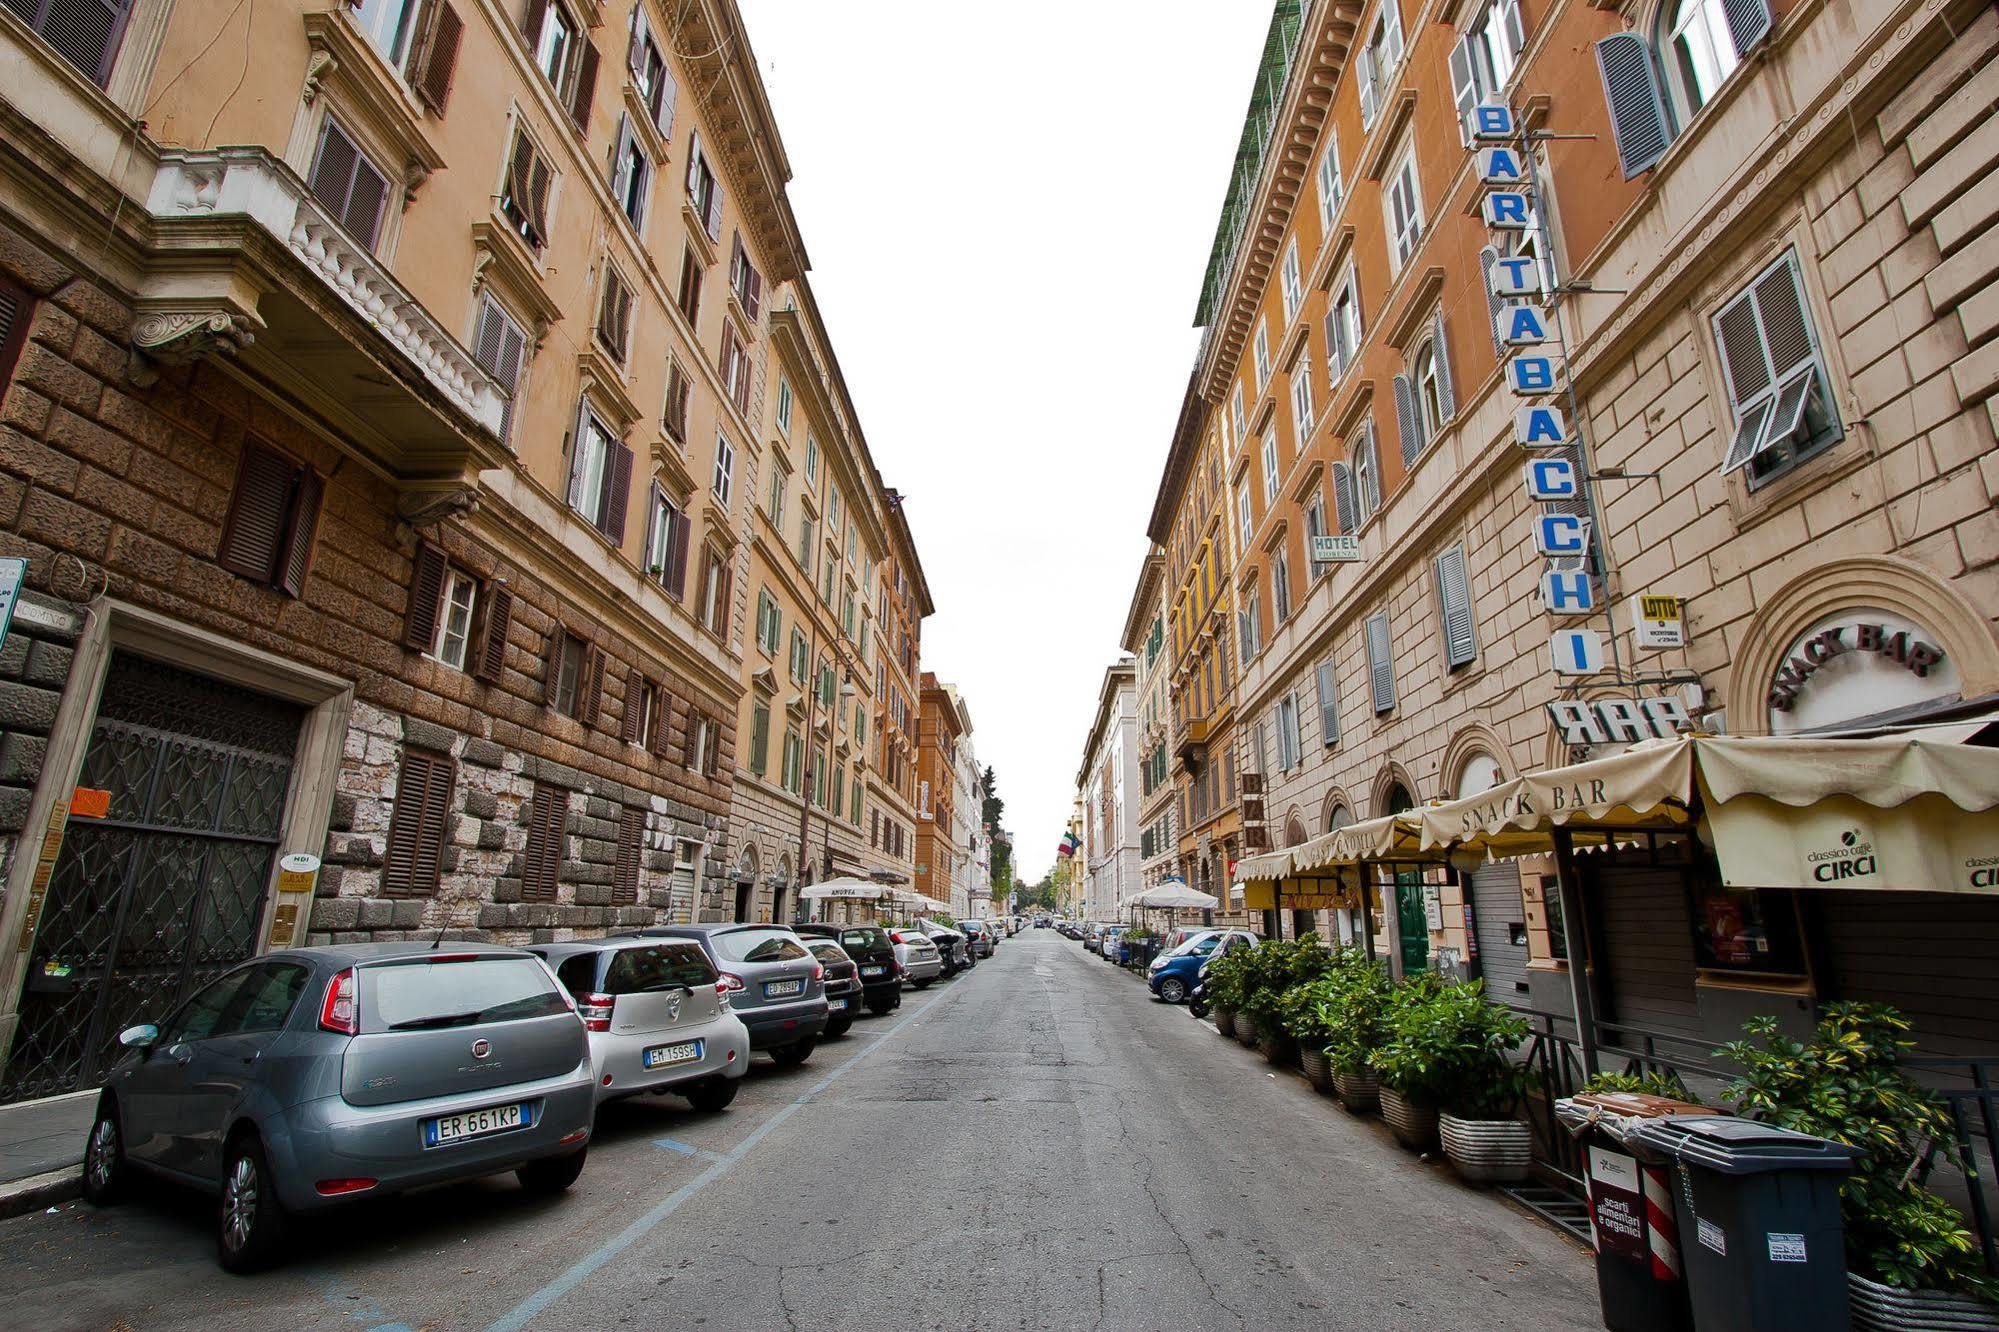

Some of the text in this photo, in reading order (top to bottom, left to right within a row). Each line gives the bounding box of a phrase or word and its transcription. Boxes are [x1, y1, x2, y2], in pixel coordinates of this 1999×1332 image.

[1477, 107, 1591, 670] BAR TABACCHI
[1314, 537, 1358, 549] HOTEL
[1642, 598, 1677, 617] LOTTO
[1767, 624, 1945, 713] SNACK BAR
[1462, 779, 1607, 832] SNACK BAR
[1807, 848, 1849, 862] classico
[1814, 855, 1876, 882] CIRCI
[1970, 868, 1999, 888] CI
[1597, 1204, 1640, 1227] alimentari
[1604, 1197, 1629, 1213] scarti
[1598, 1215, 1641, 1239] e organici
